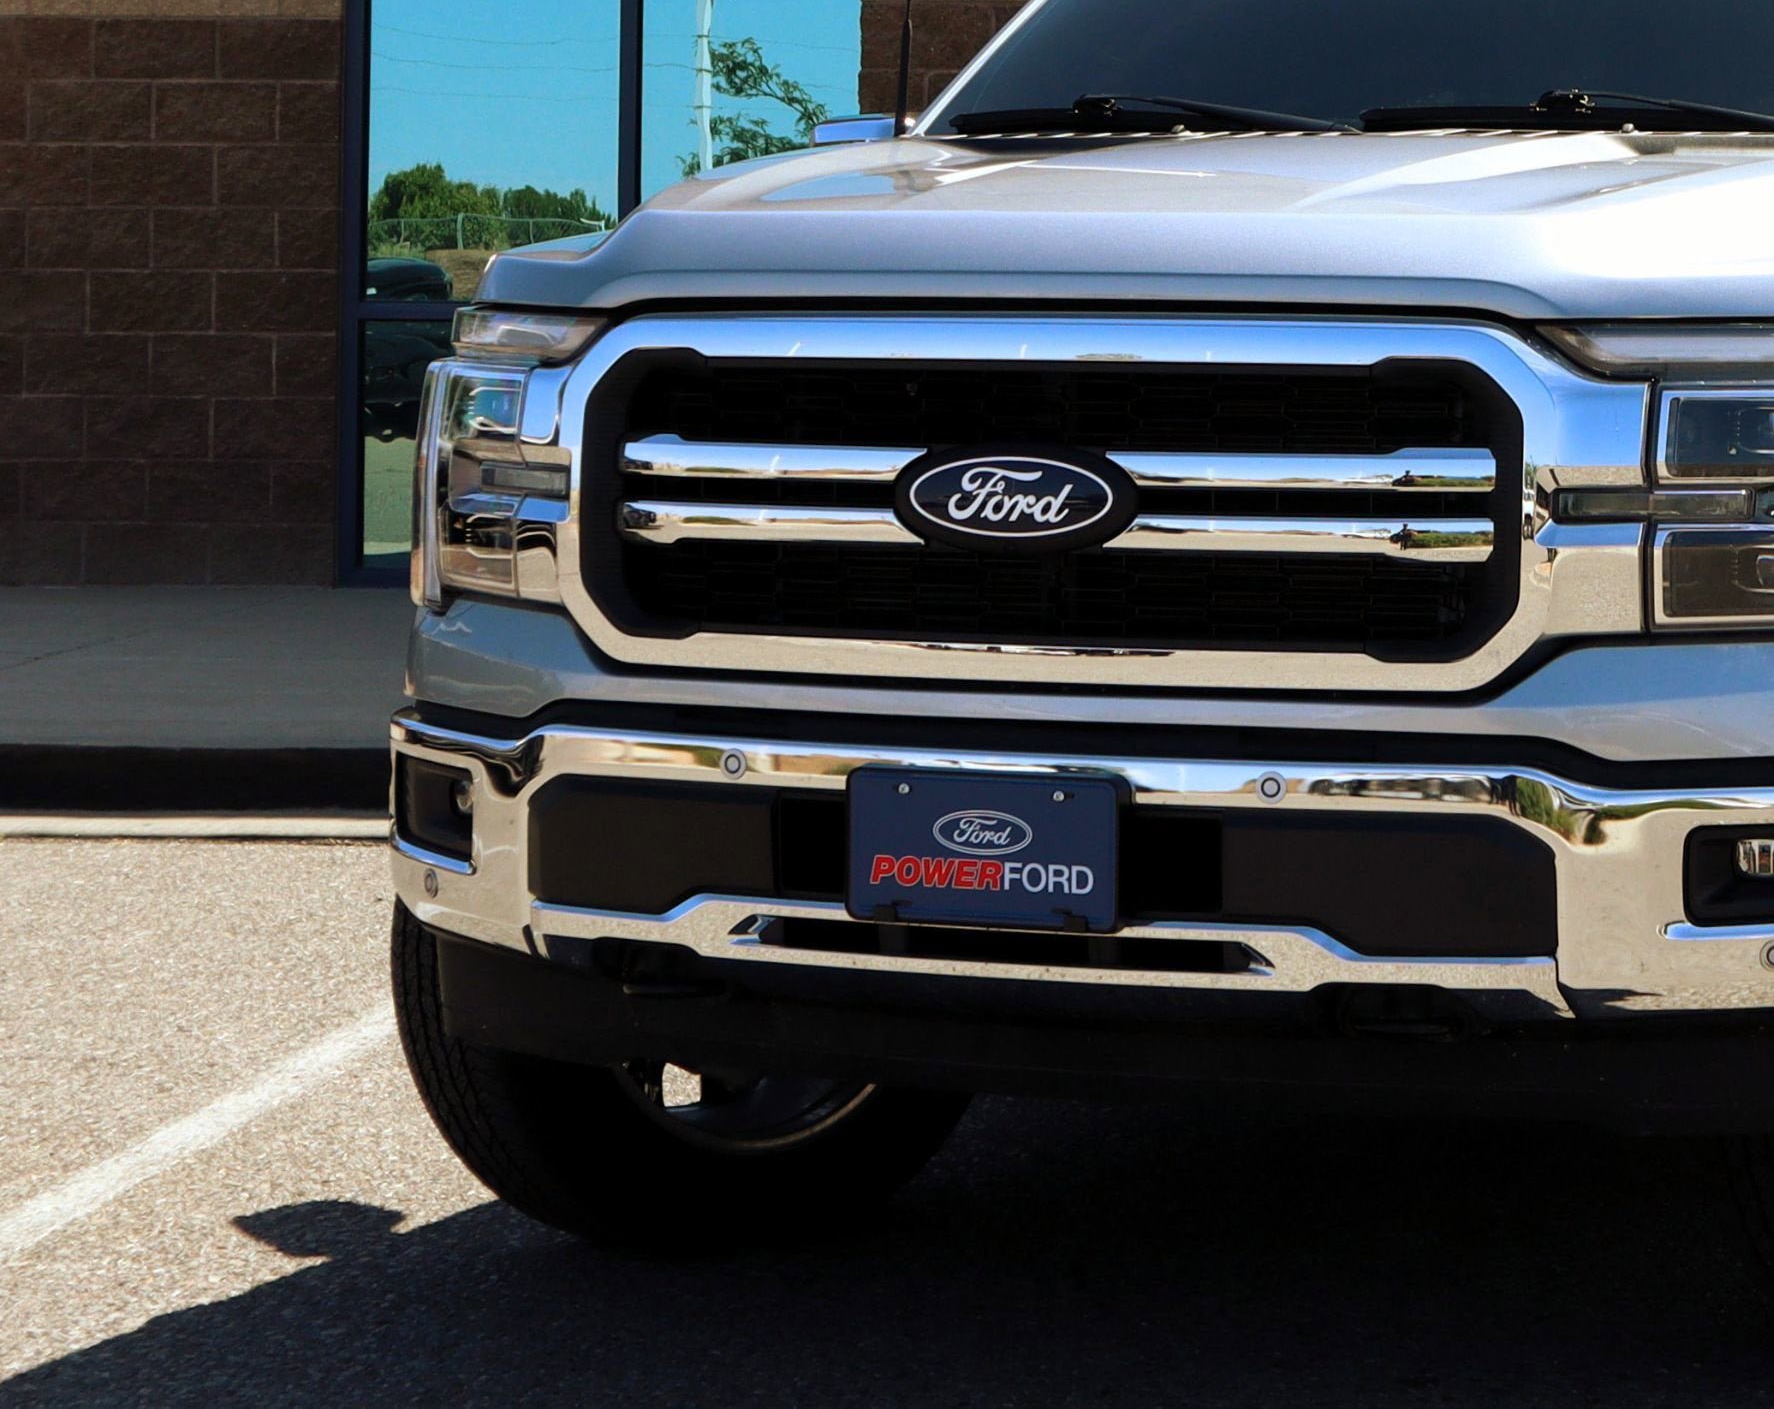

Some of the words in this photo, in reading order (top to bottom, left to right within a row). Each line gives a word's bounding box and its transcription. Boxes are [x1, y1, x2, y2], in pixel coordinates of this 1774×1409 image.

[947, 466, 1074, 524] Ford
[952, 817, 1012, 846] Ford
[869, 854, 1095, 896] POWERFORD
